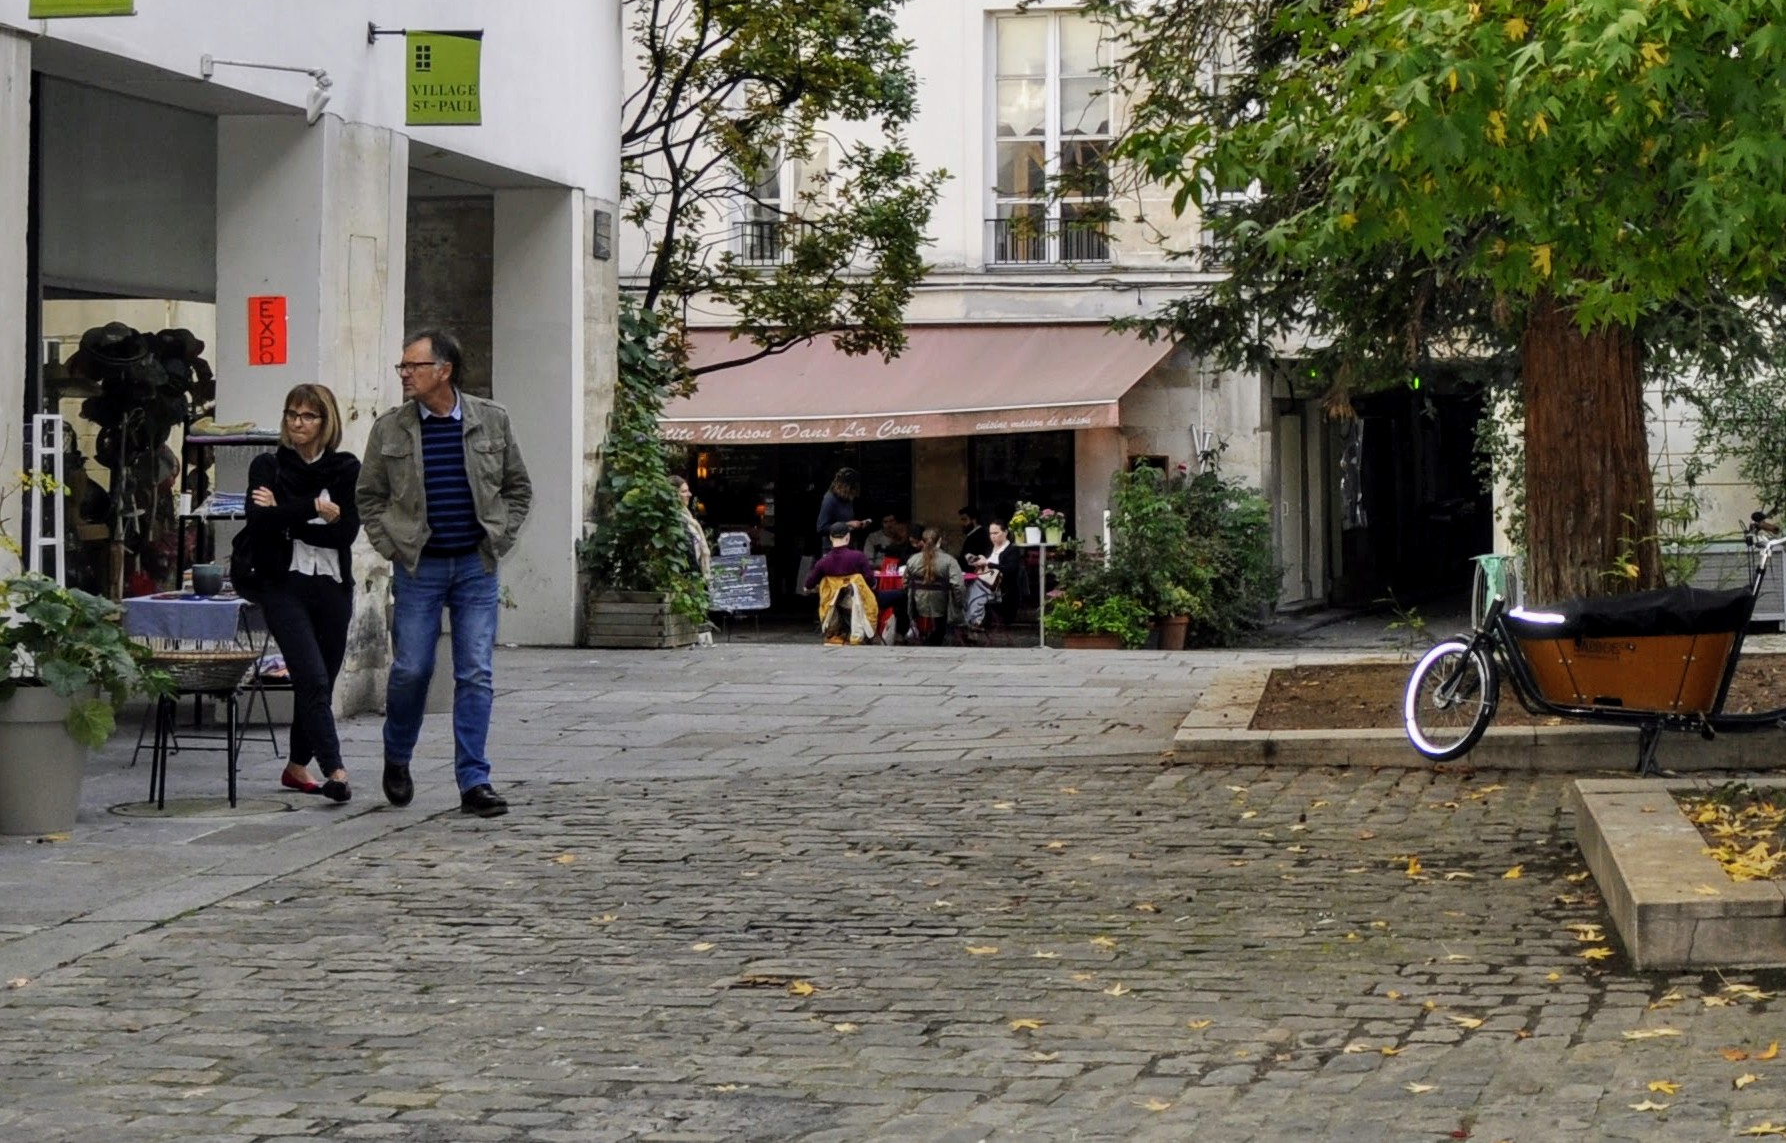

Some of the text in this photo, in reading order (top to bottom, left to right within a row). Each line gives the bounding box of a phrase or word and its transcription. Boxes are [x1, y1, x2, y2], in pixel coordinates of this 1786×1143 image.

[412, 84, 477, 96] VILLAGE
[654, 419, 922, 440] etite Maison Dans La Cour
